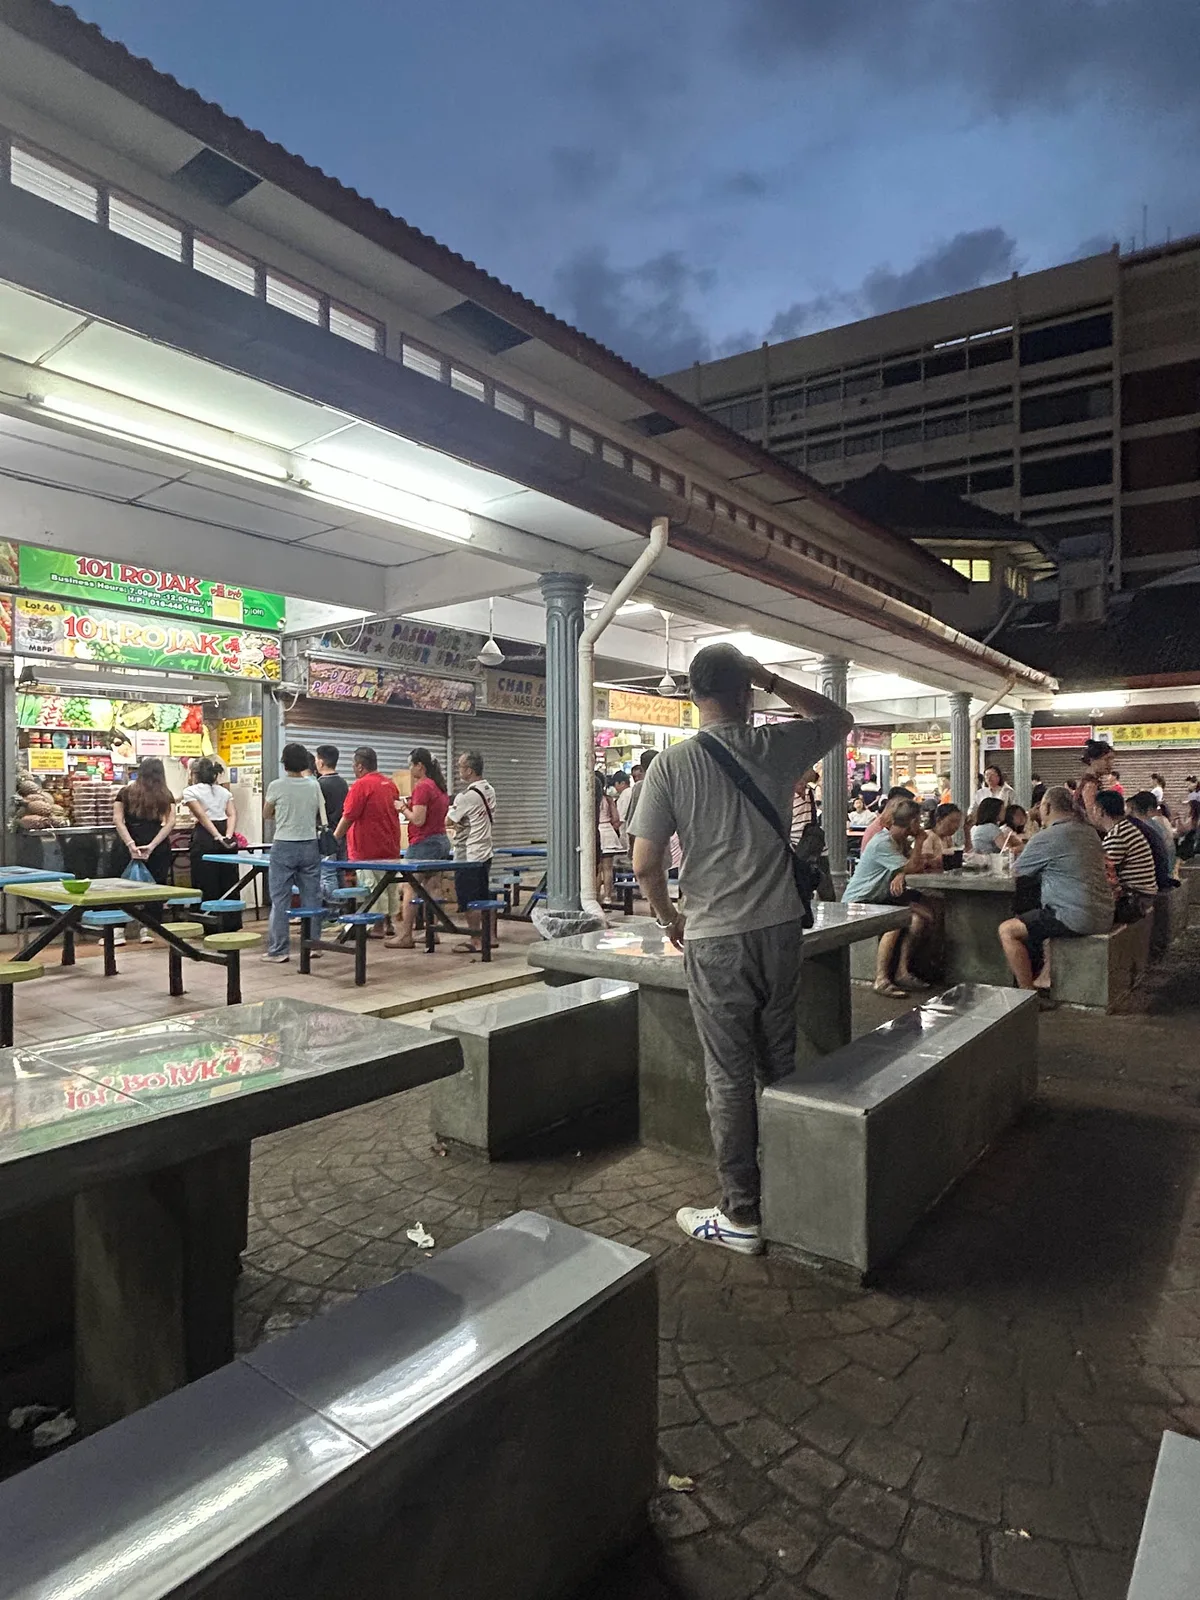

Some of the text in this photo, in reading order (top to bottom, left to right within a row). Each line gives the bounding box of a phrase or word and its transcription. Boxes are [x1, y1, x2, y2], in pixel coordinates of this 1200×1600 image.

[50, 573, 95, 588] Business
[97, 582, 127, 593] Hours:
[129, 587, 161, 599] 7.00pm
[76, 557, 201, 595] 101 ROJAK
[25, 600, 57, 612] Lot 46
[28, 643, 53, 653] MBPP
[64, 615, 220, 656] 101 ROJAK
